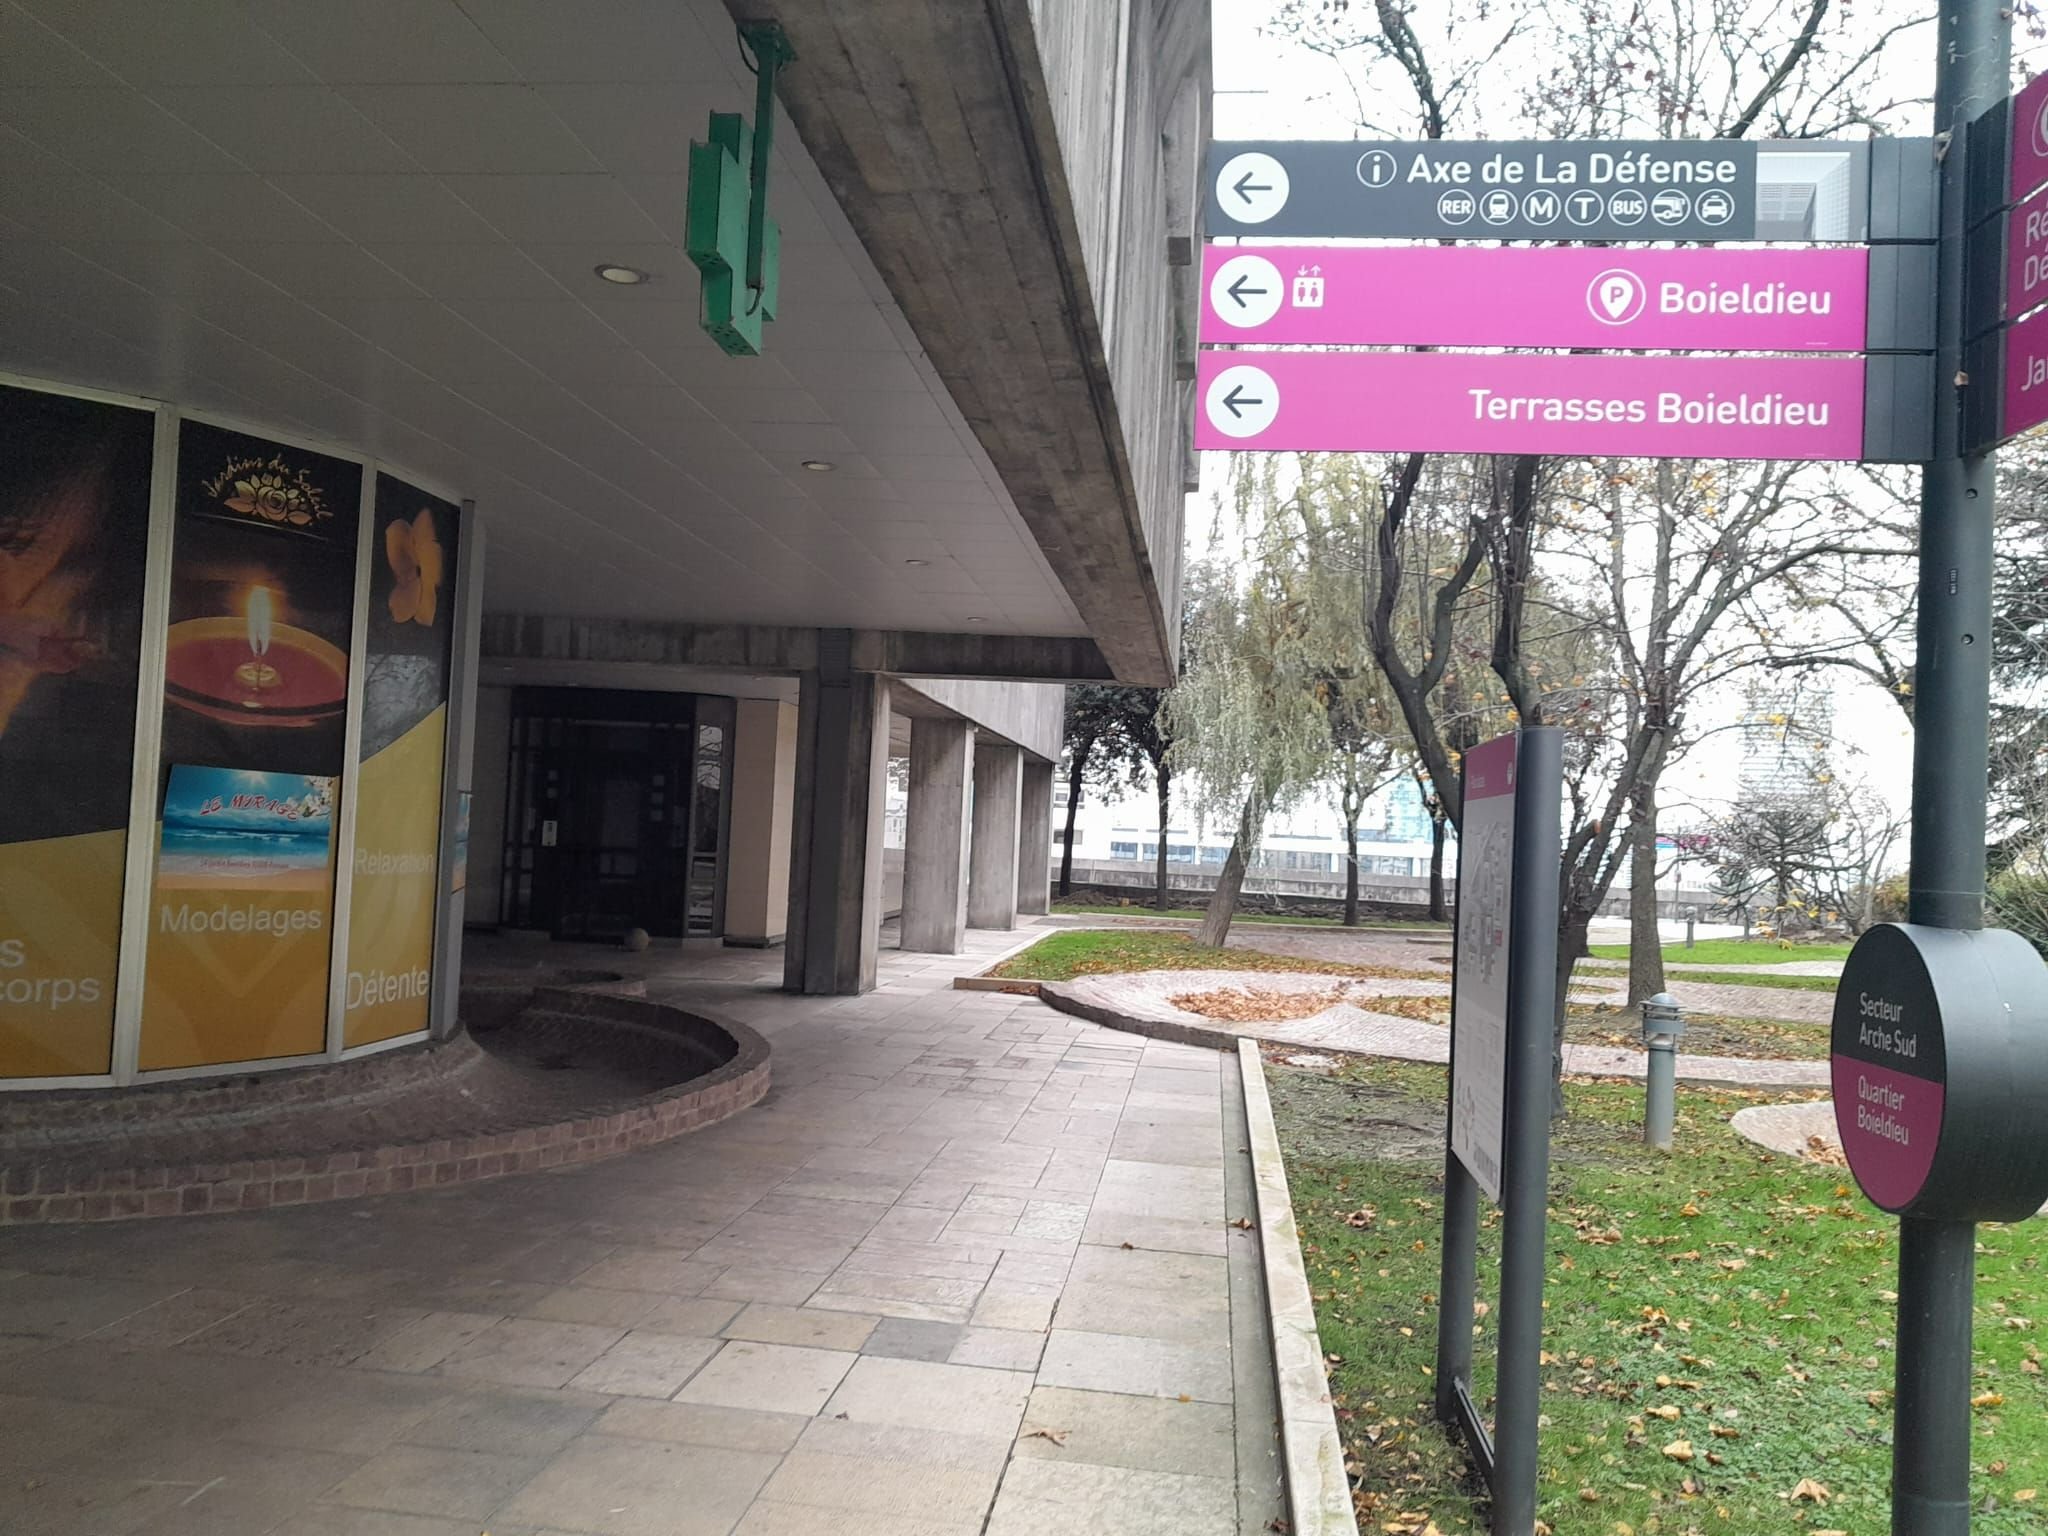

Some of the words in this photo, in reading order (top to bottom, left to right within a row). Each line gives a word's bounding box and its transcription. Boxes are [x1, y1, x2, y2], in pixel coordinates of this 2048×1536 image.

[1407, 155, 1472, 185] Axe
[1481, 154, 1523, 185] de
[1536, 154, 1577, 184] La
[1589, 150, 1737, 184] Défense
[1441, 199, 1471, 215] RER
[1529, 198, 1554, 218] M
[1574, 198, 1596, 219] T
[1612, 200, 1643, 215] BUS
[1609, 286, 1625, 303] P
[1659, 281, 1831, 315] Boieldieu
[2020, 355, 2048, 392] Ja
[1469, 389, 1647, 423] Terrasses
[1658, 392, 1829, 427] Boieldieu
[267, 452, 289, 474] du
[200, 794, 225, 816] LE
[231, 793, 299, 822] MIRAGE
[355, 847, 434, 875] Relaxation
[160, 903, 322, 937] Modelages
[0, 976, 101, 1011] orps
[347, 964, 430, 1011] Détente
[1859, 991, 1903, 1023] Secteur
[1858, 1022, 1892, 1050] Arche
[1894, 1030, 1917, 1058] Sud
[1857, 1074, 1905, 1112] Quartier
[1857, 1107, 1909, 1146] Boieldieu
